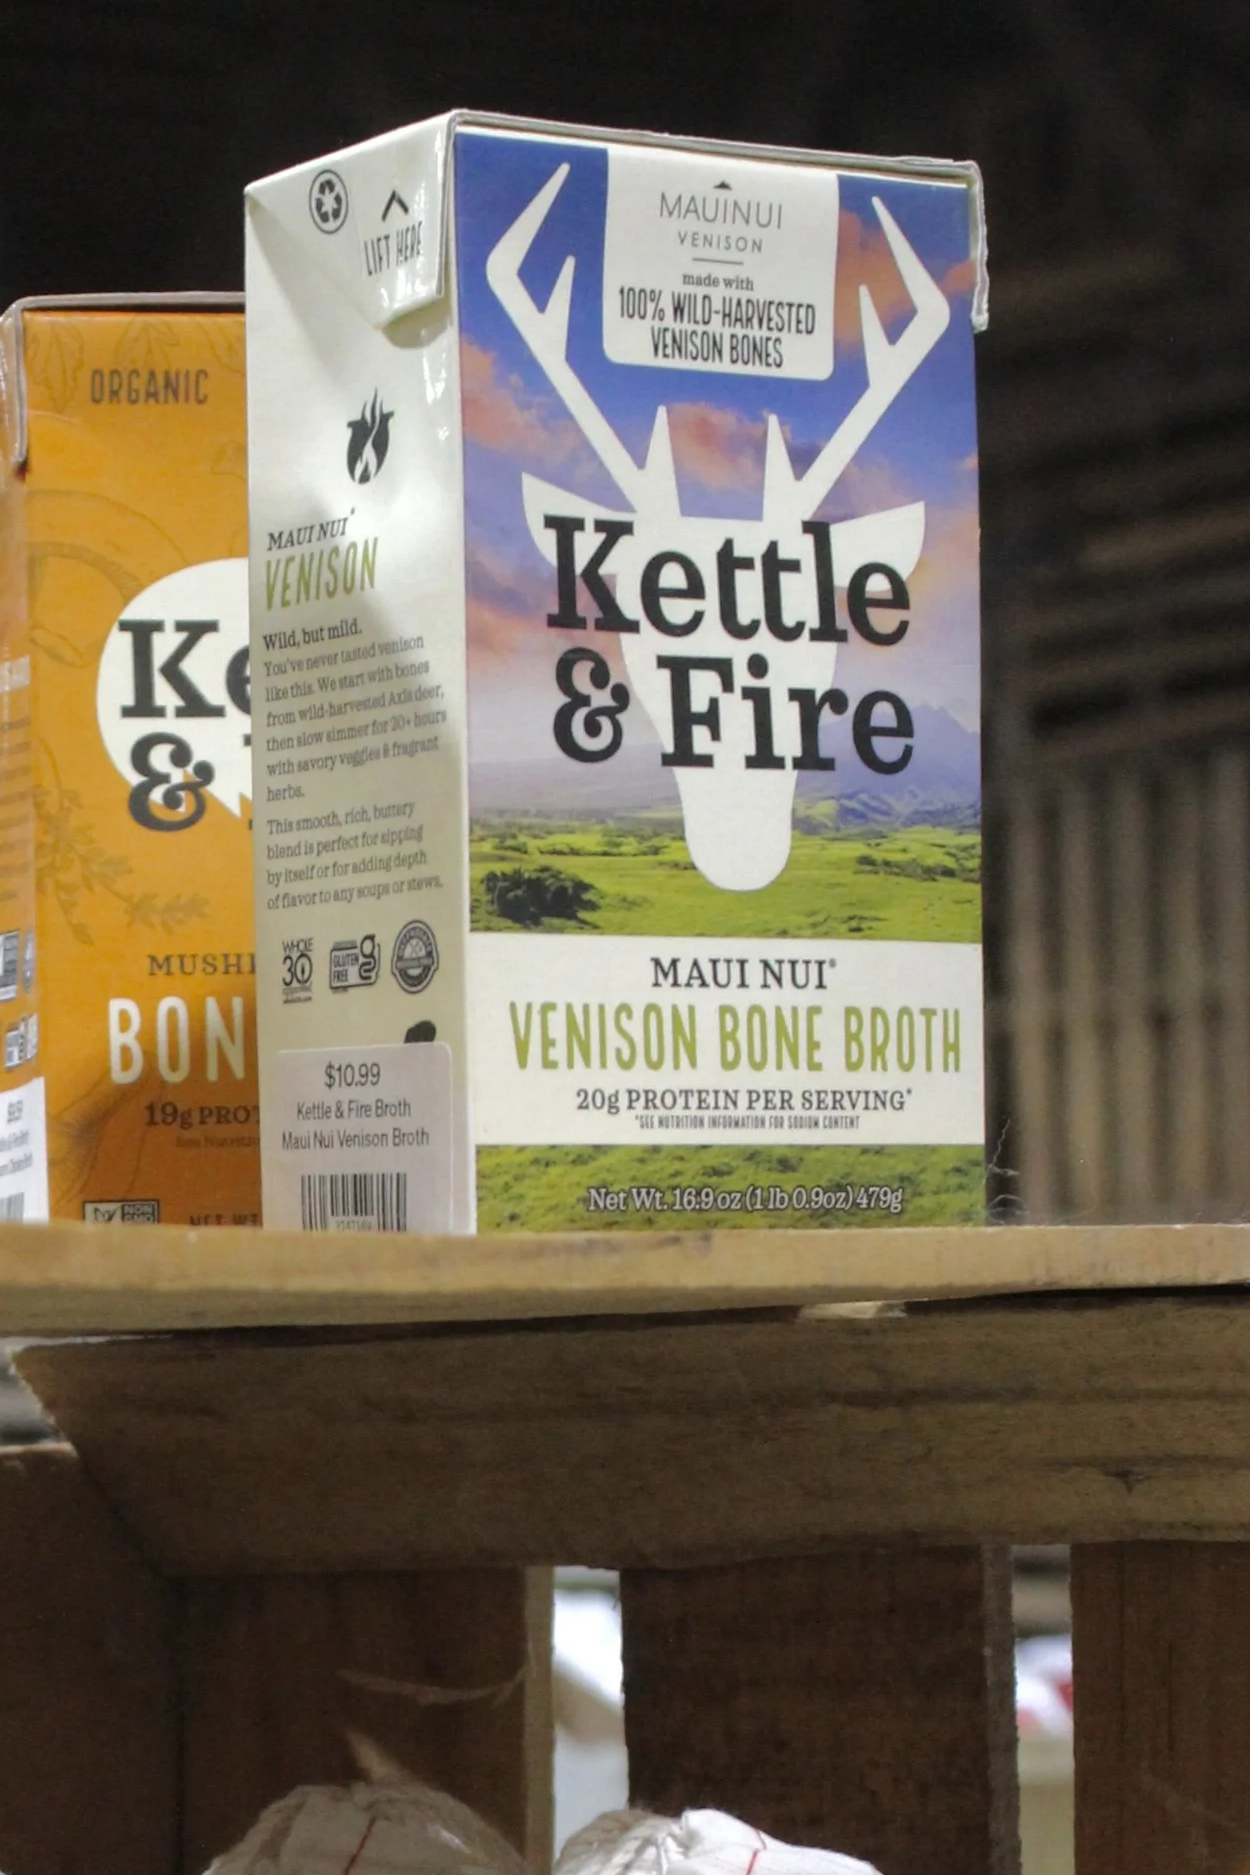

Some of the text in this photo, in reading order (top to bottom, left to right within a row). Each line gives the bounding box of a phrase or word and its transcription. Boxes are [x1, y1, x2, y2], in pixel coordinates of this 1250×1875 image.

[363, 220, 423, 277] LIFT HERE
[677, 231, 764, 253] VENISON
[681, 271, 755, 292] made with
[619, 285, 816, 335] 100% WILD-HARVESTED
[650, 326, 784, 369] VENISON BONES
[90, 368, 210, 405] ORGANIC
[266, 524, 316, 552] MAUI
[265, 536, 379, 611] VENISON
[543, 513, 911, 648] Kettle
[263, 617, 363, 652] Wild, but mild.
[263, 634, 424, 677] You've never tasted venison
[265, 660, 430, 703] like We start with bones
[266, 710, 296, 728] from
[552, 647, 915, 776] & Fire
[266, 708, 447, 752] then slow simmer for hours
[266, 736, 440, 777] with savory veggies fragrant
[128, 732, 215, 833] &
[266, 783, 305, 802] herbs.
[266, 801, 416, 836] This smooth, rich, buttery
[266, 823, 424, 861] blend is perfect for sipping
[266, 848, 428, 888] by itself or for adding depth
[266, 874, 444, 910] of flavor to any soups or stews.
[282, 938, 314, 954] WHOLE
[333, 952, 360, 968] GLUTEN
[281, 953, 313, 988] 30
[333, 970, 349, 982] FREE
[650, 957, 750, 989] MAUI
[508, 1001, 962, 1074] VENISON BONE BROTH
[324, 1060, 381, 1091] $10.99
[144, 1101, 194, 1129] 19g
[296, 1097, 411, 1120] Kettle & Fire Broth
[575, 1088, 621, 1115] 20g
[625, 1088, 740, 1112] PROTEIN
[746, 1088, 796, 1112] PER
[281, 1130, 310, 1150] Maui
[313, 1129, 334, 1149] Nui
[336, 1127, 389, 1149] Venison
[391, 1126, 430, 1148] Broth
[657, 1114, 861, 1131] NUTRITION INFORMATION FOR SODIUM CONTENT
[587, 1186, 903, 1213] Net Wt. 16.9 oz (1 lb 0.9oz) 479g
